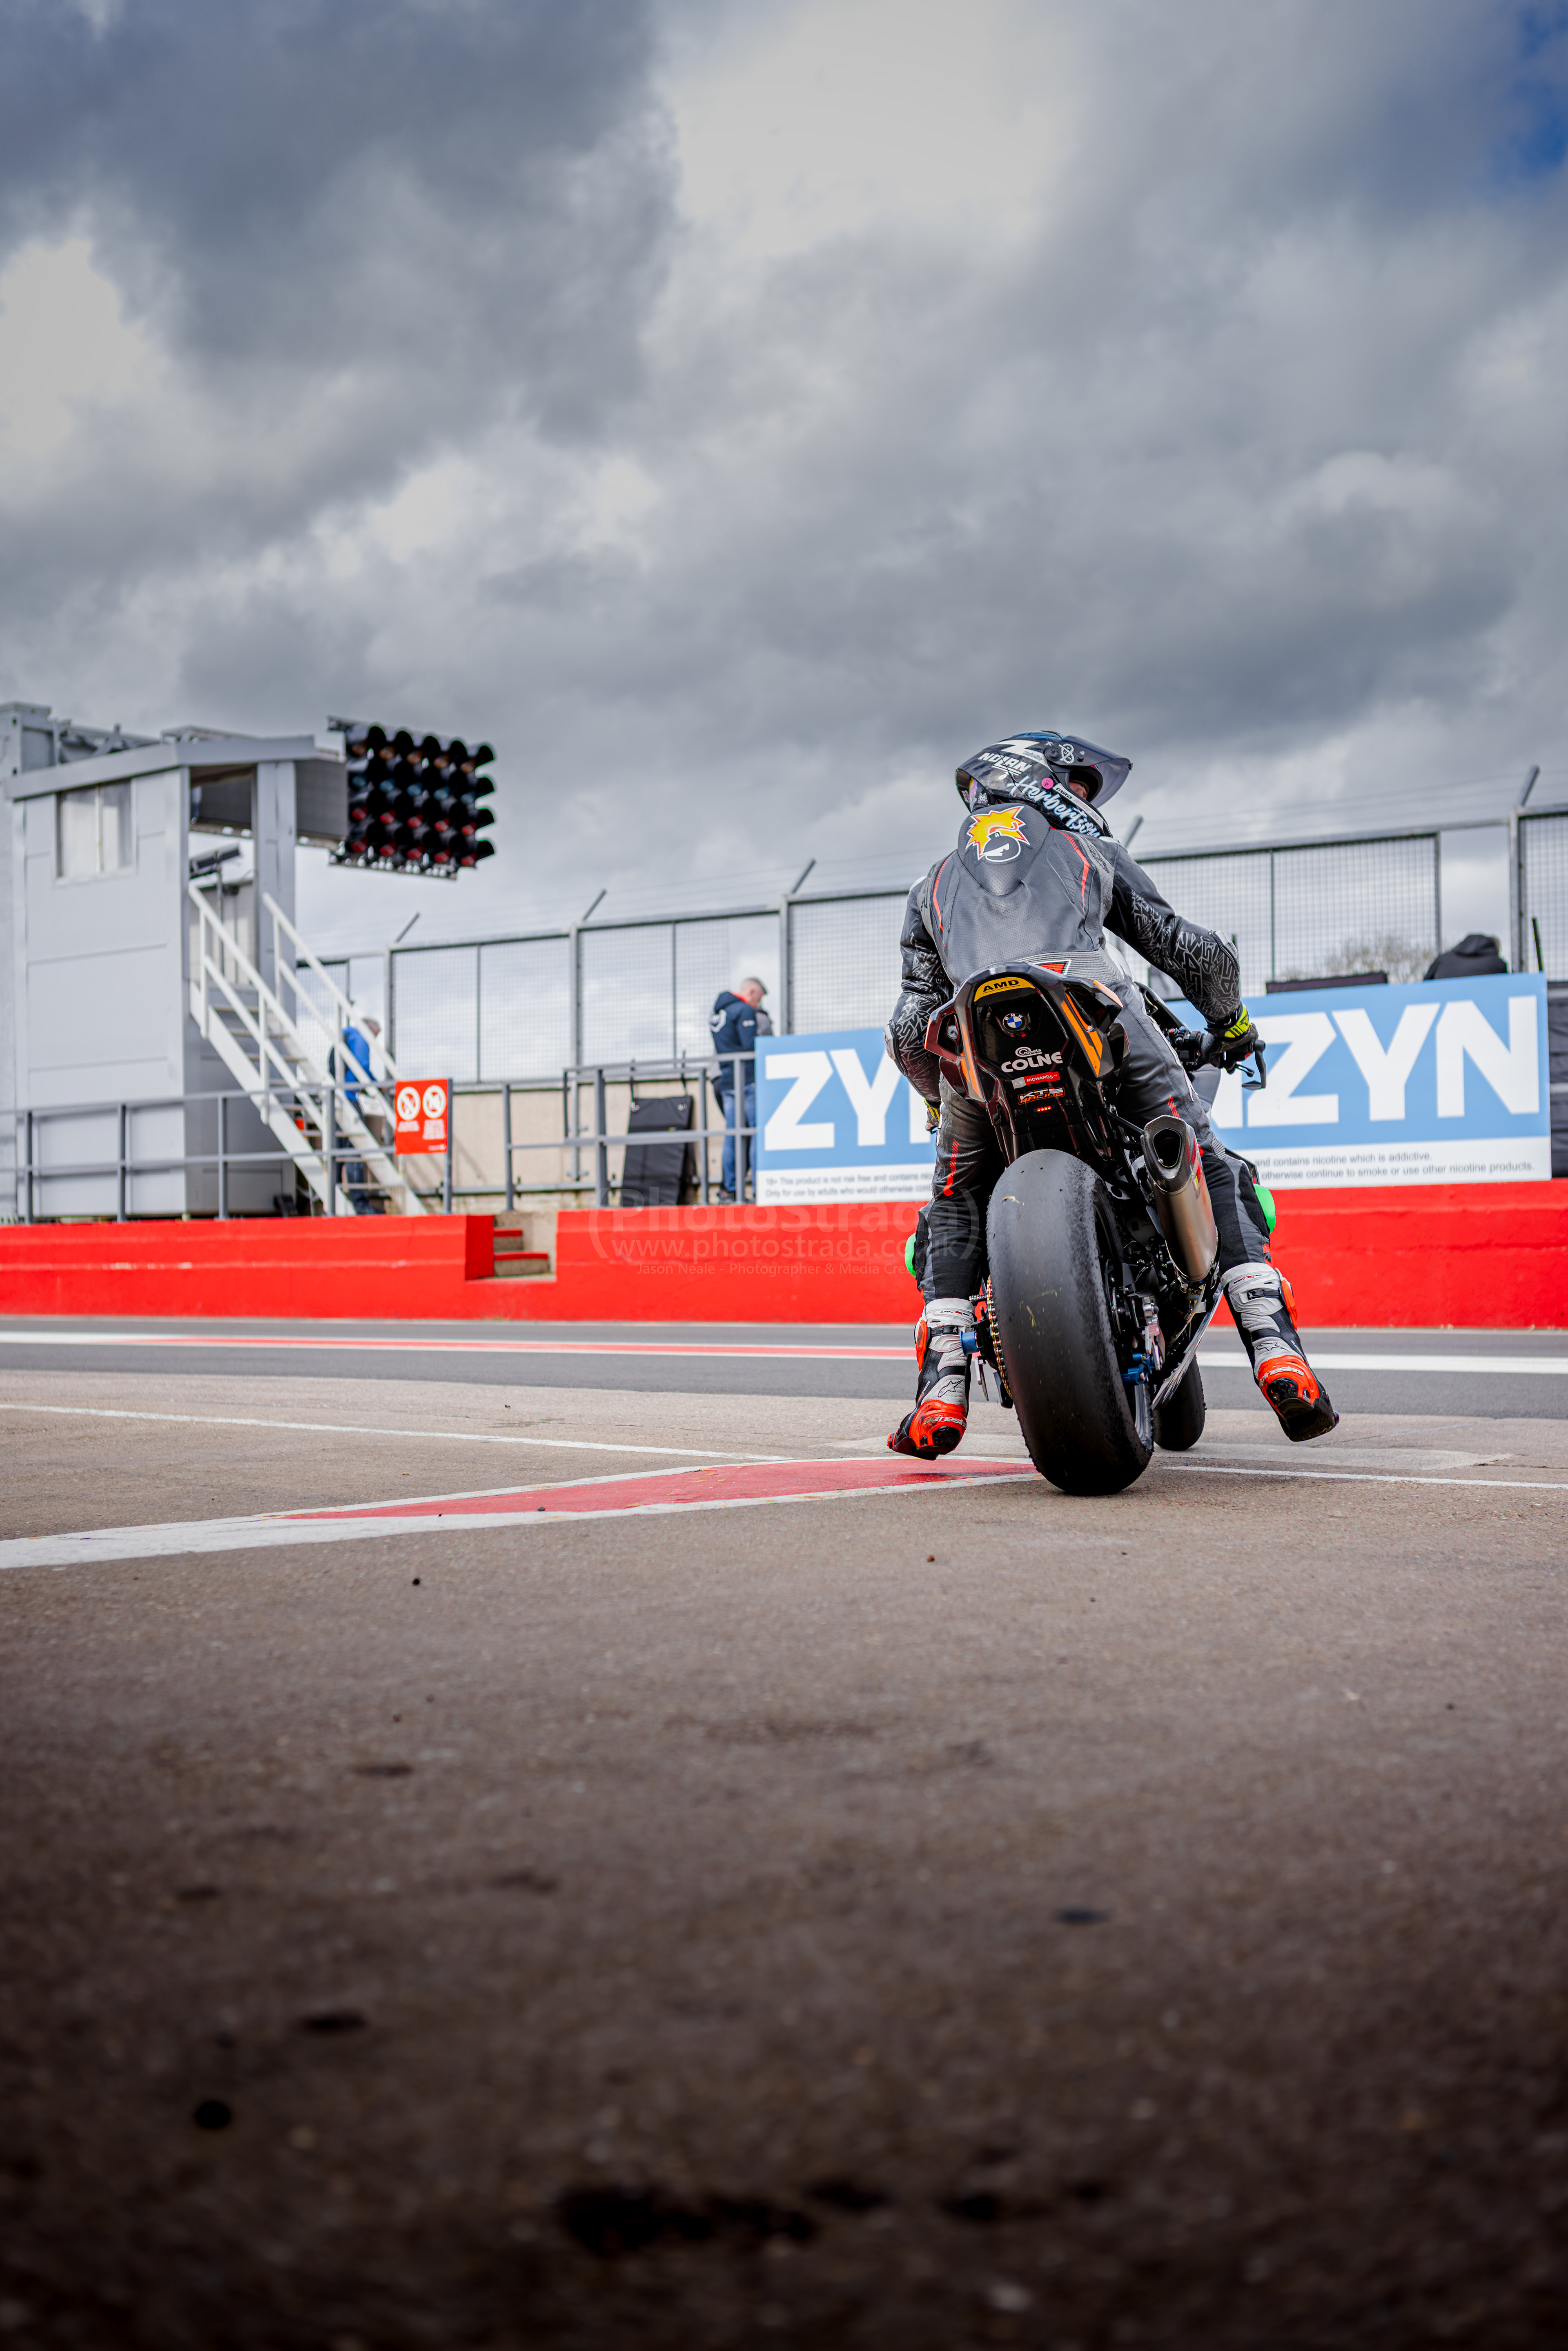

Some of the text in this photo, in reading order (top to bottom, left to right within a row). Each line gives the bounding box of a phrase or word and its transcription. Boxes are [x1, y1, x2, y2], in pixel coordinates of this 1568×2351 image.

[978, 752, 1032, 773] NOLAN
[983, 980, 1019, 992] AMD
[1001, 1051, 1063, 1073] COLNE
[1020, 1092, 1064, 1103] RACING
[1273, 1156, 1310, 1167] contains
[1313, 1155, 1347, 1165] nicotine
[1350, 1153, 1376, 1163] which
[1379, 1152, 1386, 1162] is
[1389, 1151, 1432, 1162] addictive.
[1261, 1170, 1303, 1180] otherwise
[1306, 1169, 1344, 1179] continue
[1347, 1168, 1355, 1177] to
[1358, 1166, 1388, 1177] smoke
[1391, 1167, 1399, 1175] or
[1403, 1167, 1419, 1176] use
[1423, 1165, 1446, 1174] other
[1450, 1163, 1486, 1174] nicotine
